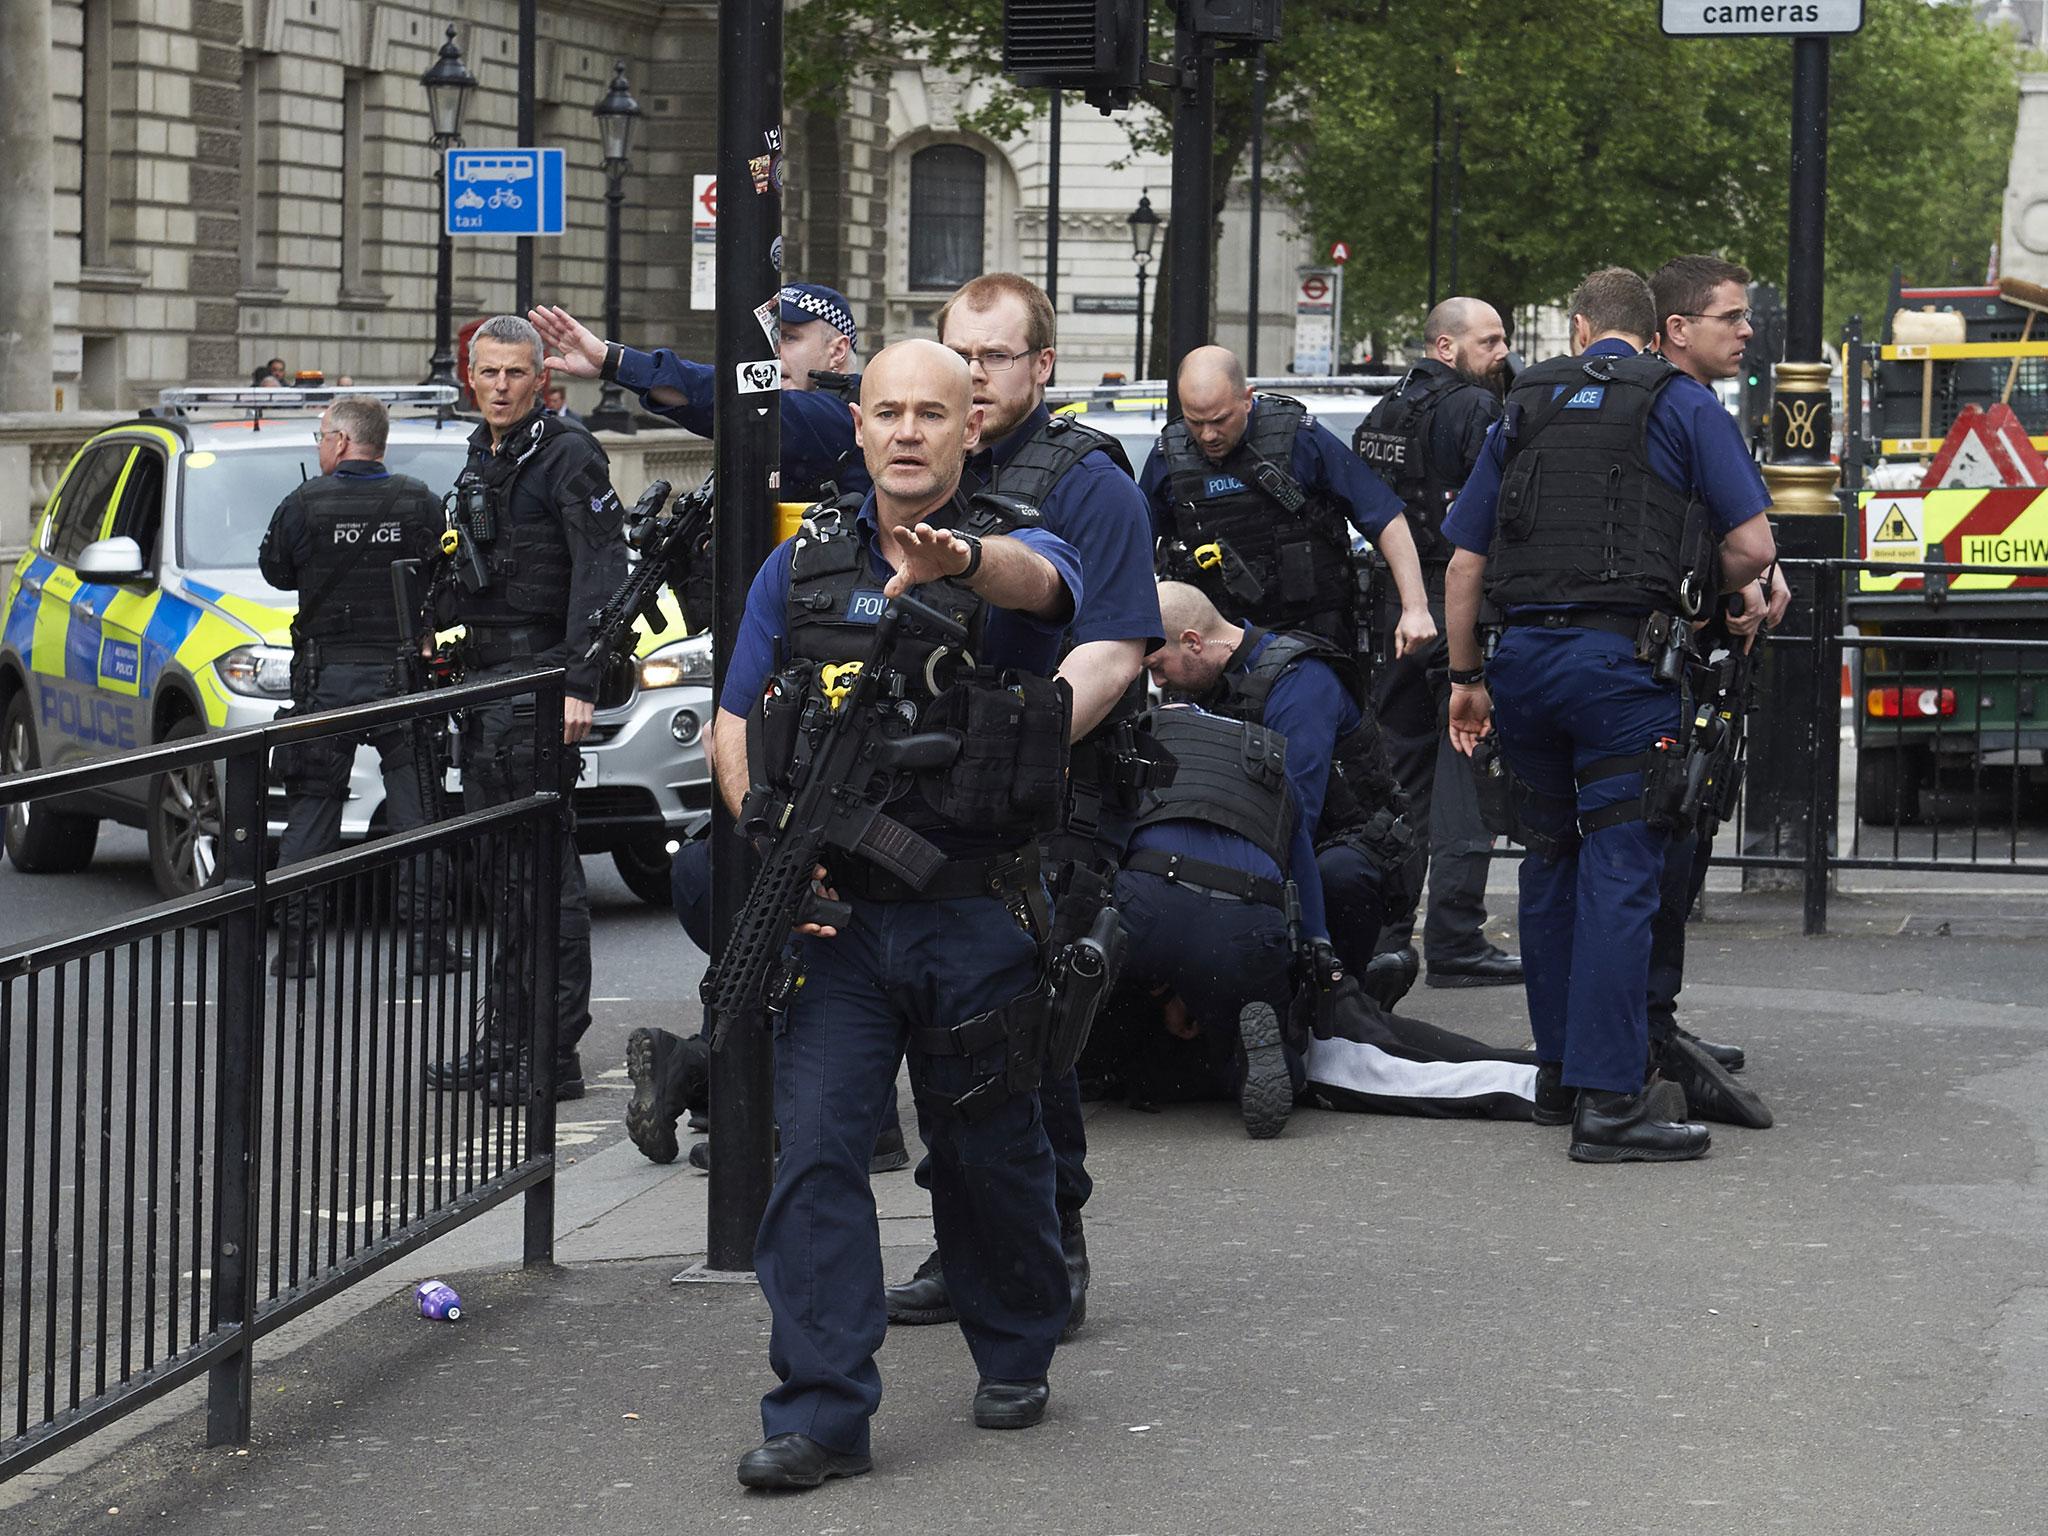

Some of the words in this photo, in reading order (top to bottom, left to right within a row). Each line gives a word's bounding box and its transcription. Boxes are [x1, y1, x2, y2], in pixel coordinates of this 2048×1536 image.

[1703, 5, 1819, 24] cameras
[455, 214, 483, 228] taxi
[1332, 243, 1348, 259] A
[1360, 440, 1406, 464] POLICE
[334, 528, 402, 544] POICE
[115, 661, 134, 676] POLICE
[41, 685, 137, 751] POLICE
